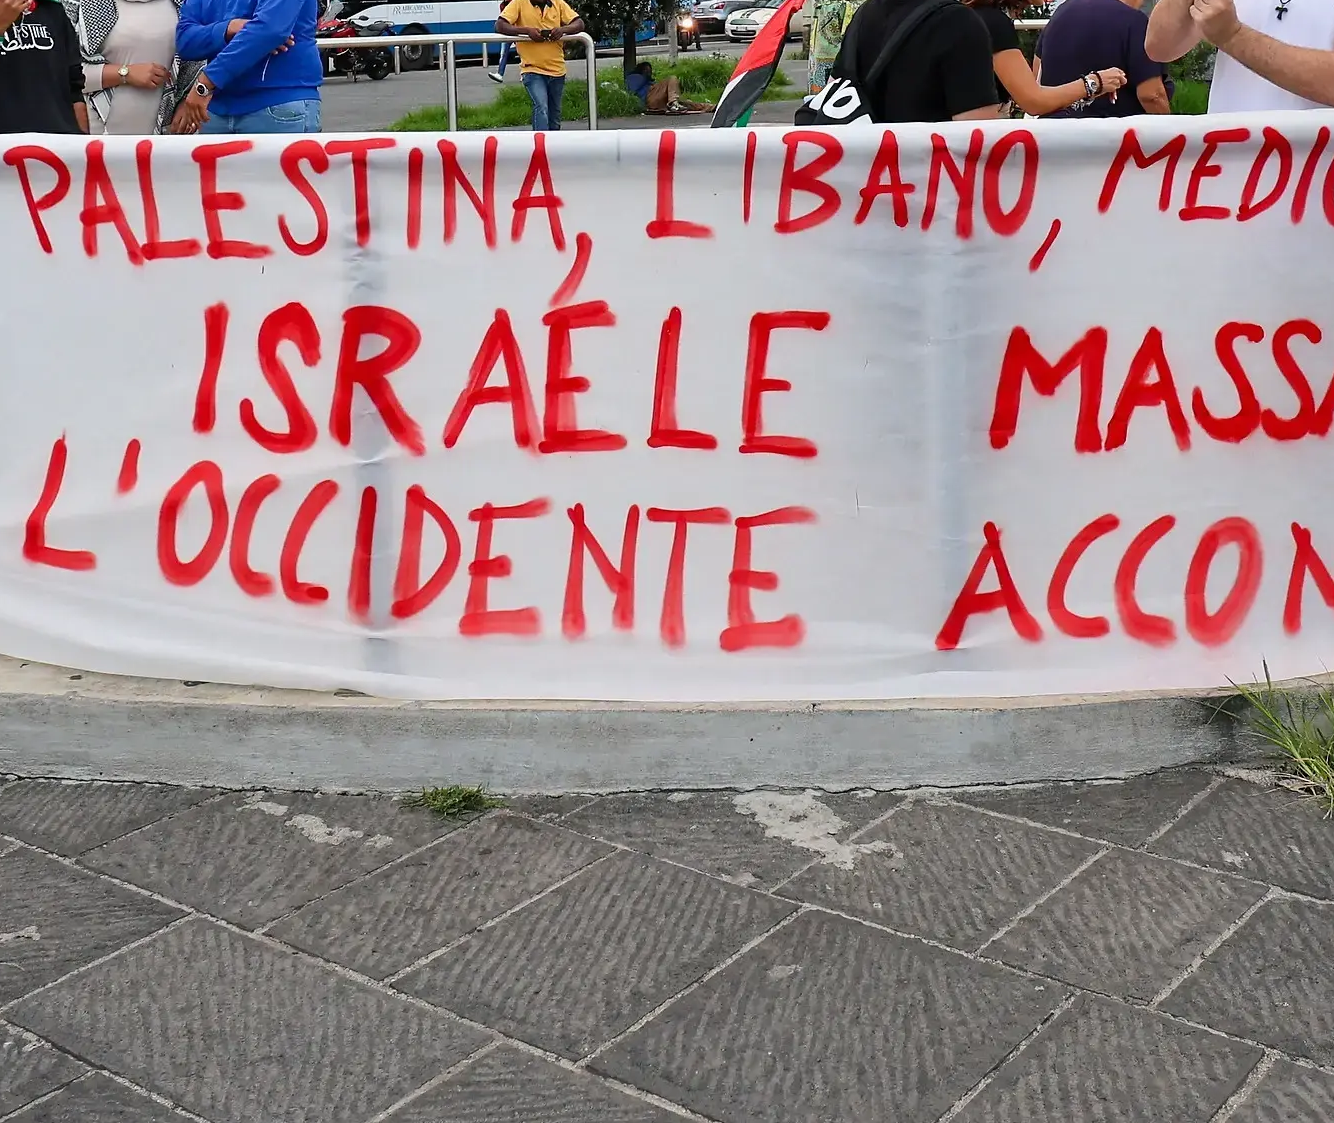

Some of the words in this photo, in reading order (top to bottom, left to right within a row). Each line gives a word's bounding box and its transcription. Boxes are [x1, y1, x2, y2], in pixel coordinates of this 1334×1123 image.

[3, 133, 592, 305] PALESTINA,
[646, 129, 1061, 271] LIBANO,
[193, 301, 830, 458] ISRAELE
[23, 436, 815, 653] L'OCCIDENTE
